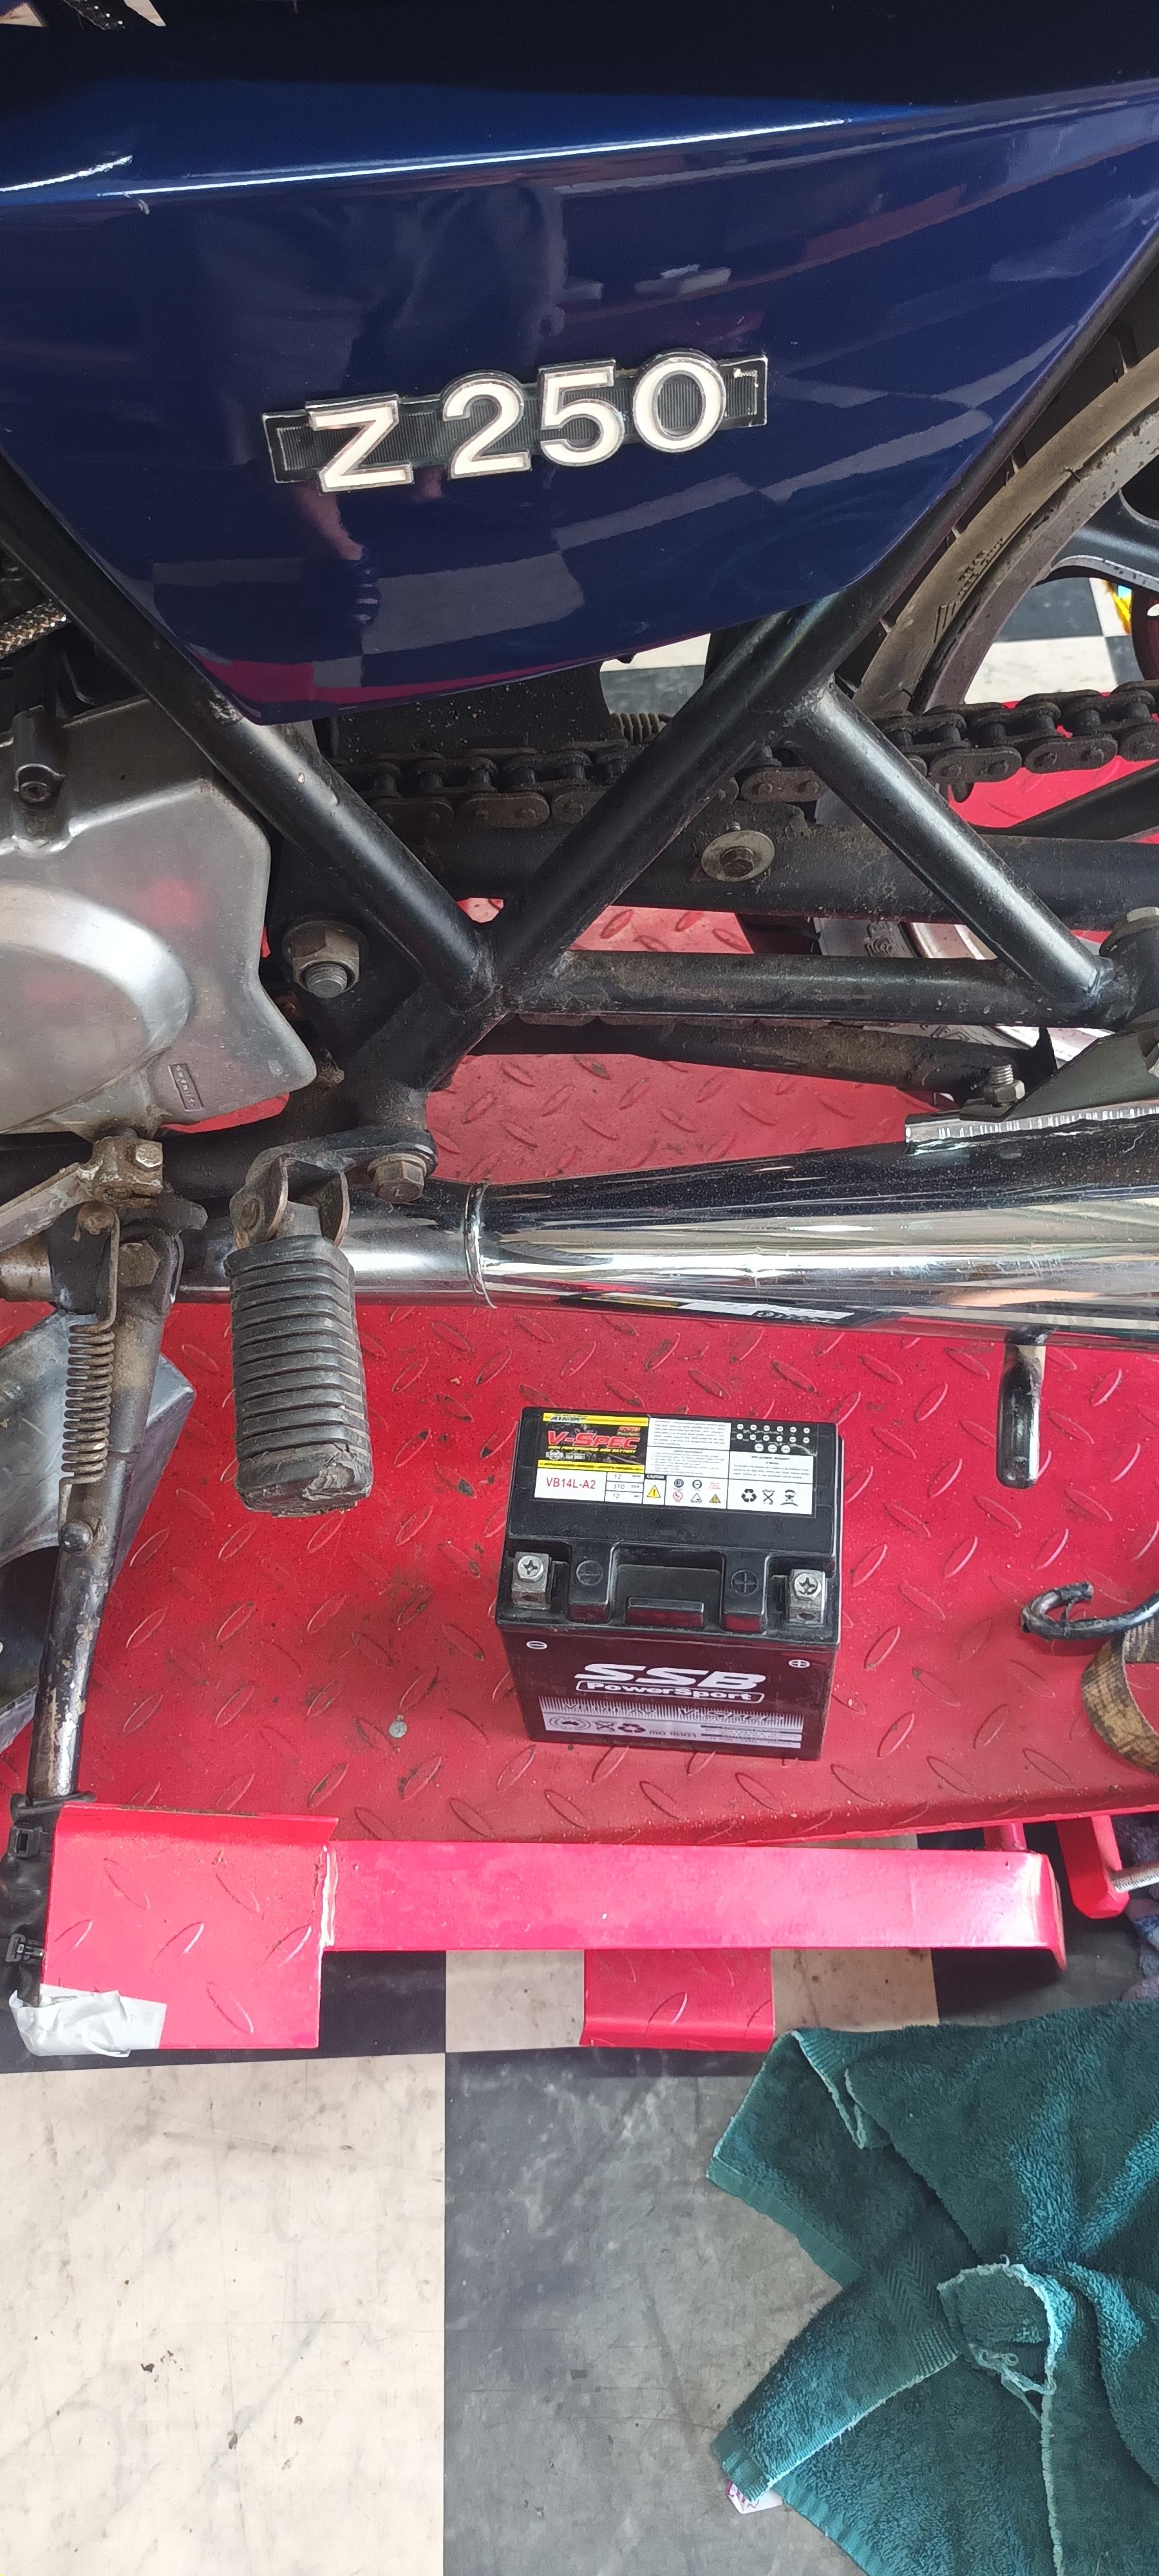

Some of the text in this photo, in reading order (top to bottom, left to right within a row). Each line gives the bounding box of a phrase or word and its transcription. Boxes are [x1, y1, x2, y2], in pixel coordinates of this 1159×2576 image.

[308, 353, 726, 494] Z 250
[546, 1477, 596, 1490] VB14L-A2
[574, 1663, 766, 1690] SSB
[586, 1681, 753, 1701] PowerSport
